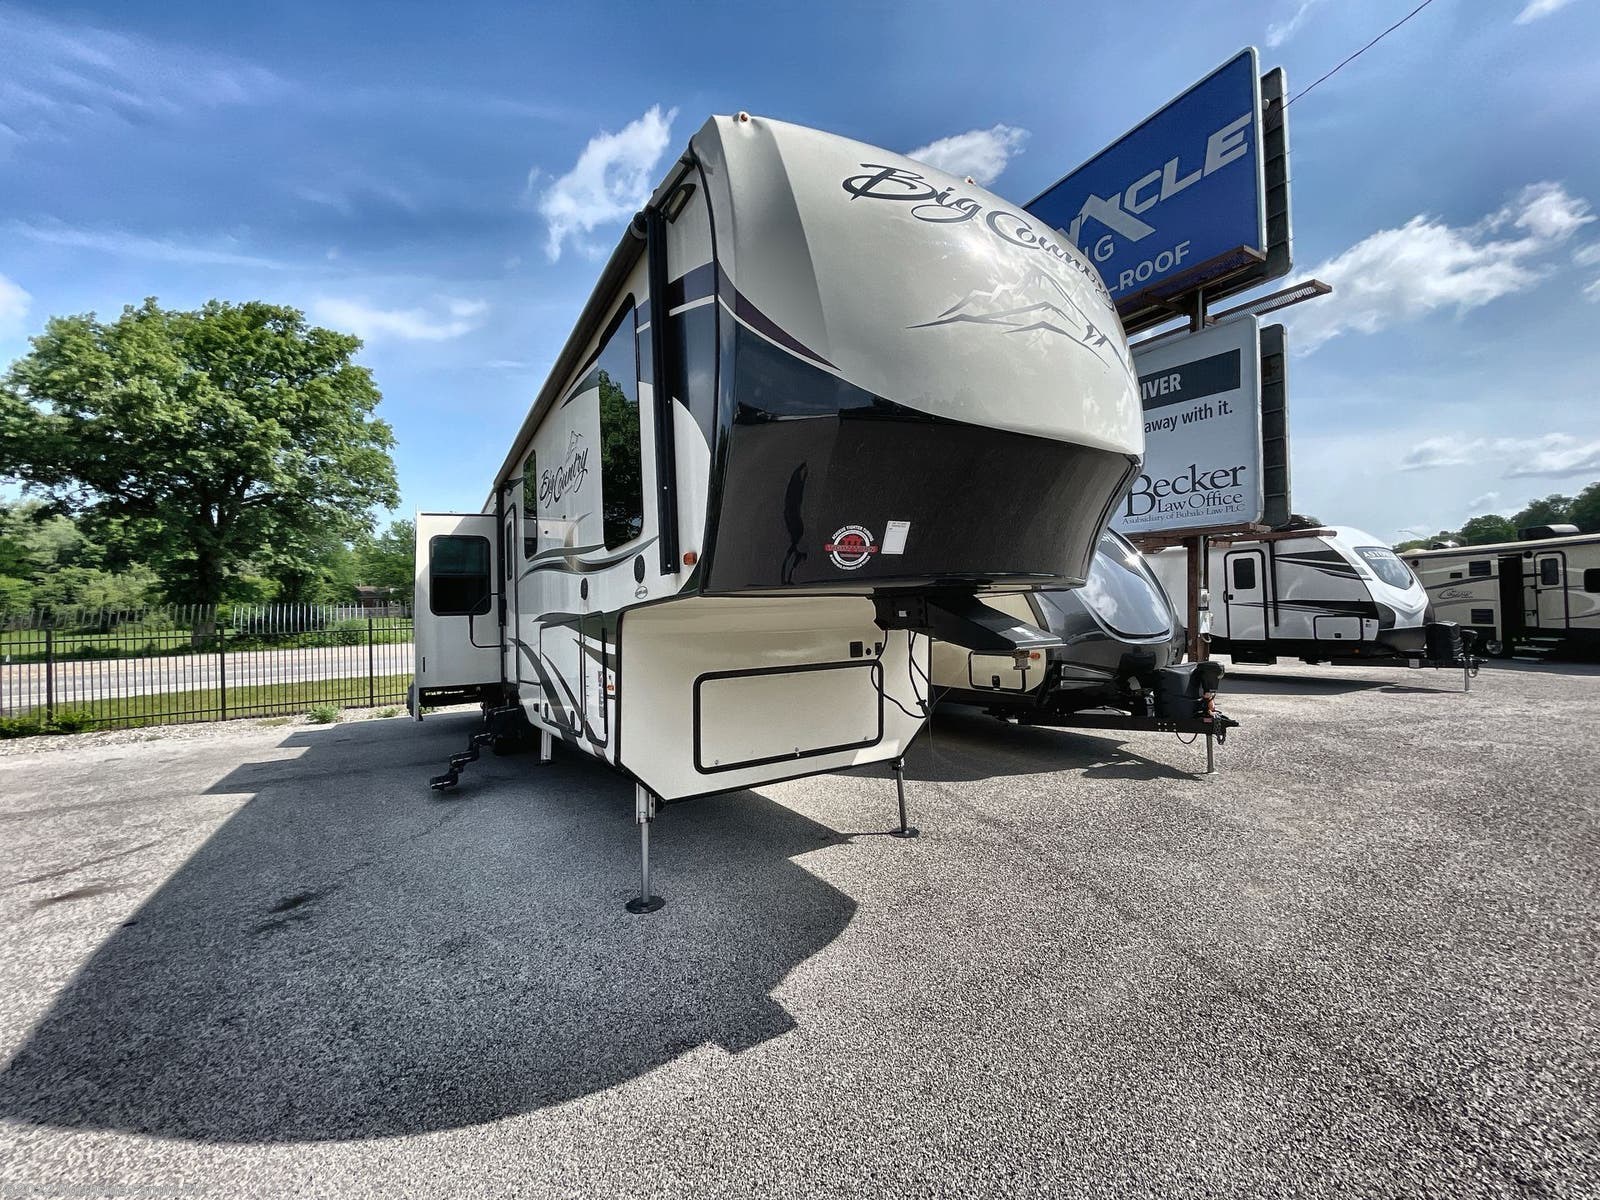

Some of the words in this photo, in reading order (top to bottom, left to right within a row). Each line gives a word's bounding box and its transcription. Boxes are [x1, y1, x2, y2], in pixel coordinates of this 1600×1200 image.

[842, 163, 983, 223] Big
[1144, 415, 1177, 433] away
[1182, 402, 1213, 424] with
[1218, 400, 1233, 416] it.
[540, 469, 555, 508] Big
[1123, 464, 1246, 518] Becker
[1158, 499, 1187, 513] Law
[1189, 491, 1243, 508] Office
[1206, 507, 1224, 516] Law
[1225, 504, 1245, 513] PLC
